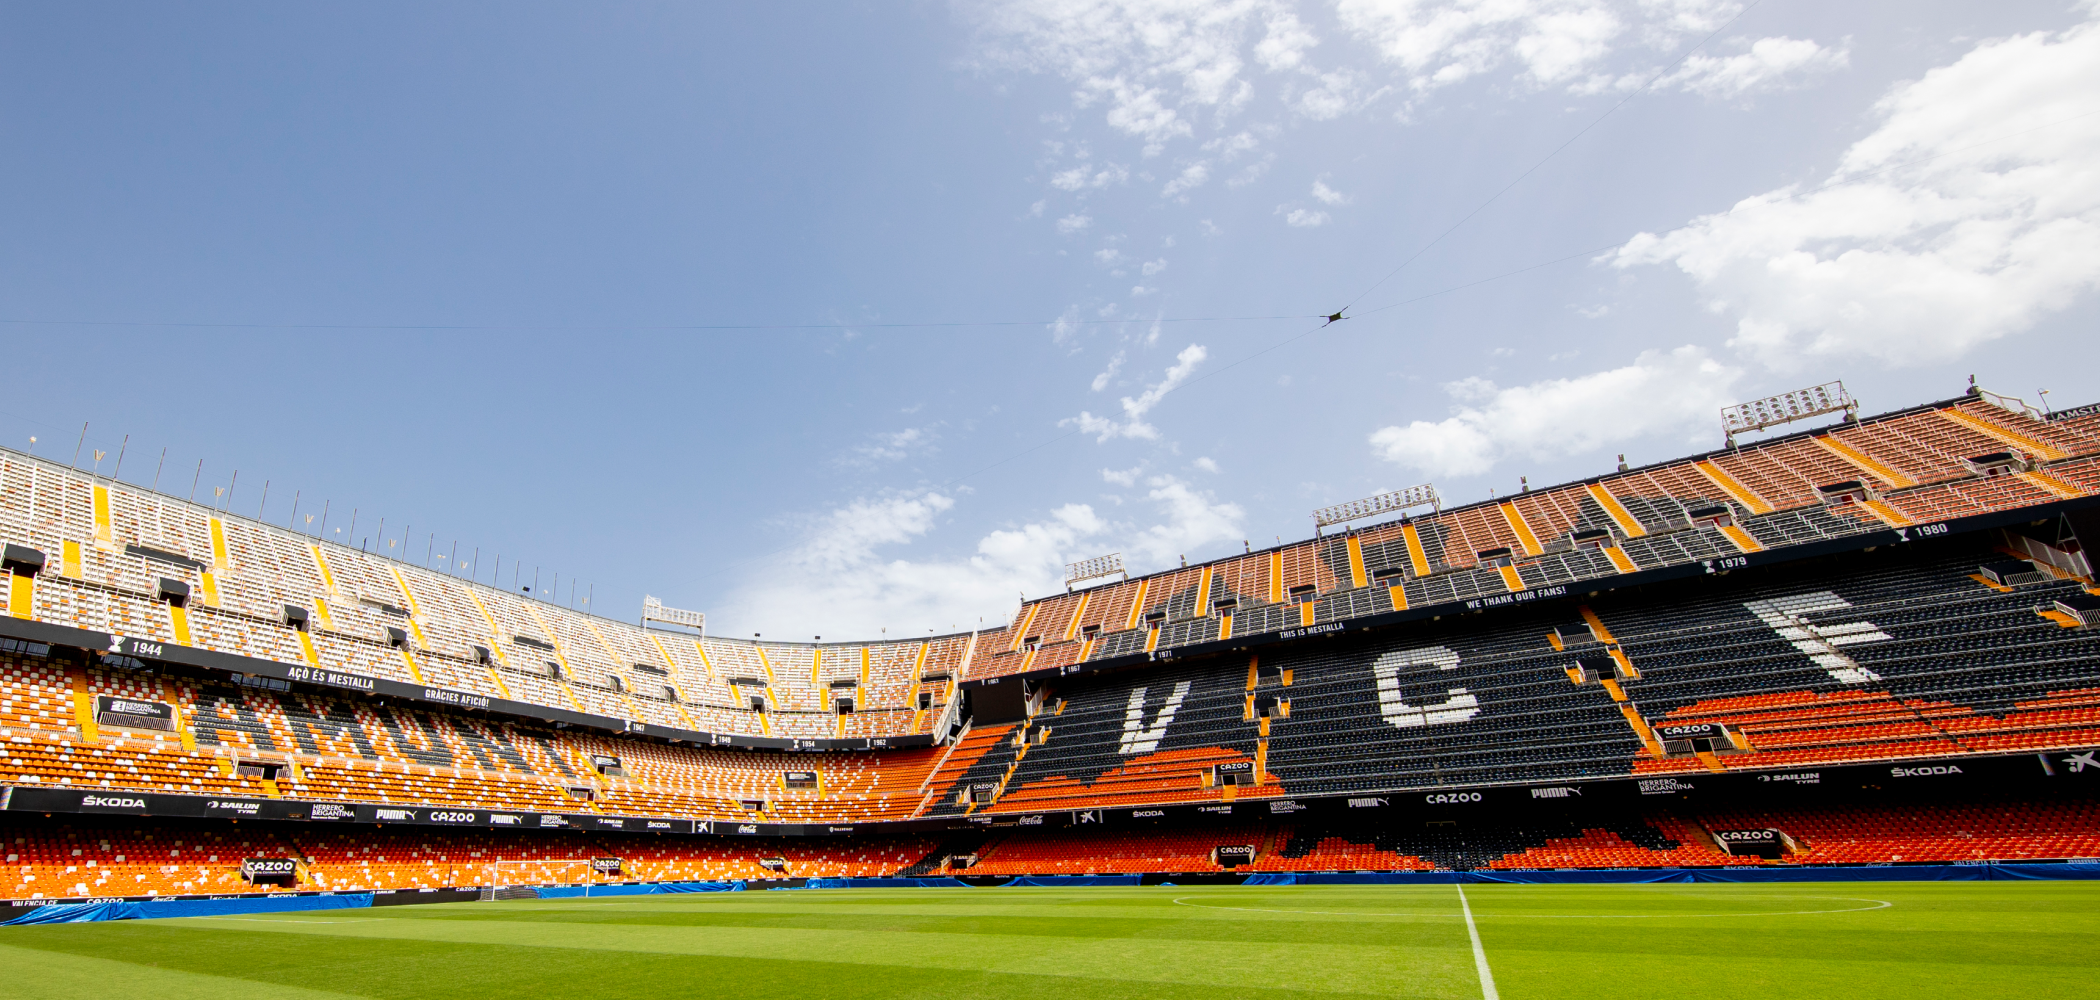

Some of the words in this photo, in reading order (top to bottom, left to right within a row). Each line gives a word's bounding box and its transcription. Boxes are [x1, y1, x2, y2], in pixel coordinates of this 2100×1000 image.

[1915, 523, 1949, 538] 1980
[1718, 556, 1747, 569] 1979
[1466, 599, 1481, 609] WE
[1482, 593, 1513, 607] THANK
[1515, 590, 1536, 602] OUR
[1538, 585, 1567, 600] FANS!
[1279, 630, 1296, 639] THIS
[1297, 628, 1304, 636] IS
[1307, 621, 1345, 635] MESTALLA
[133, 641, 163, 656] 1944
[1158, 649, 1173, 659] 1971
[1118, 681, 1192, 754] V
[1373, 645, 1481, 728] C
[1743, 590, 1894, 684] F
[288, 666, 310, 681] AÇÒ
[312, 669, 326, 682] ÉS
[327, 673, 374, 690] MESTALLA
[425, 688, 459, 703] GRÀCIES
[460, 694, 490, 707] AFICIÓ!
[633, 722, 645, 733] 1947
[1664, 724, 1711, 735] CAZOO
[1220, 763, 1250, 771] CAZOO
[1890, 766, 1963, 777] ŠKODA
[1773, 773, 1820, 781] SAILUN
[1638, 779, 1678, 788] HERRERO
[1640, 783, 1695, 792] BRIGANTINA
[1425, 792, 1482, 804] CAZOO
[1531, 787, 1569, 798] PUMA
[82, 795, 146, 808] ŠKODA
[1348, 798, 1379, 807] PUMA
[311, 810, 355, 818] BRIGANTINA
[376, 809, 406, 820] PUMA
[430, 811, 475, 822] CAZOO
[490, 814, 515, 824] PUMA
[1133, 810, 1165, 818] ŠKODA
[647, 821, 671, 829] ŠKODA
[1721, 831, 1774, 840] CAZOO
[1221, 846, 1251, 854] CAZOO
[246, 861, 293, 871] CAZOO
